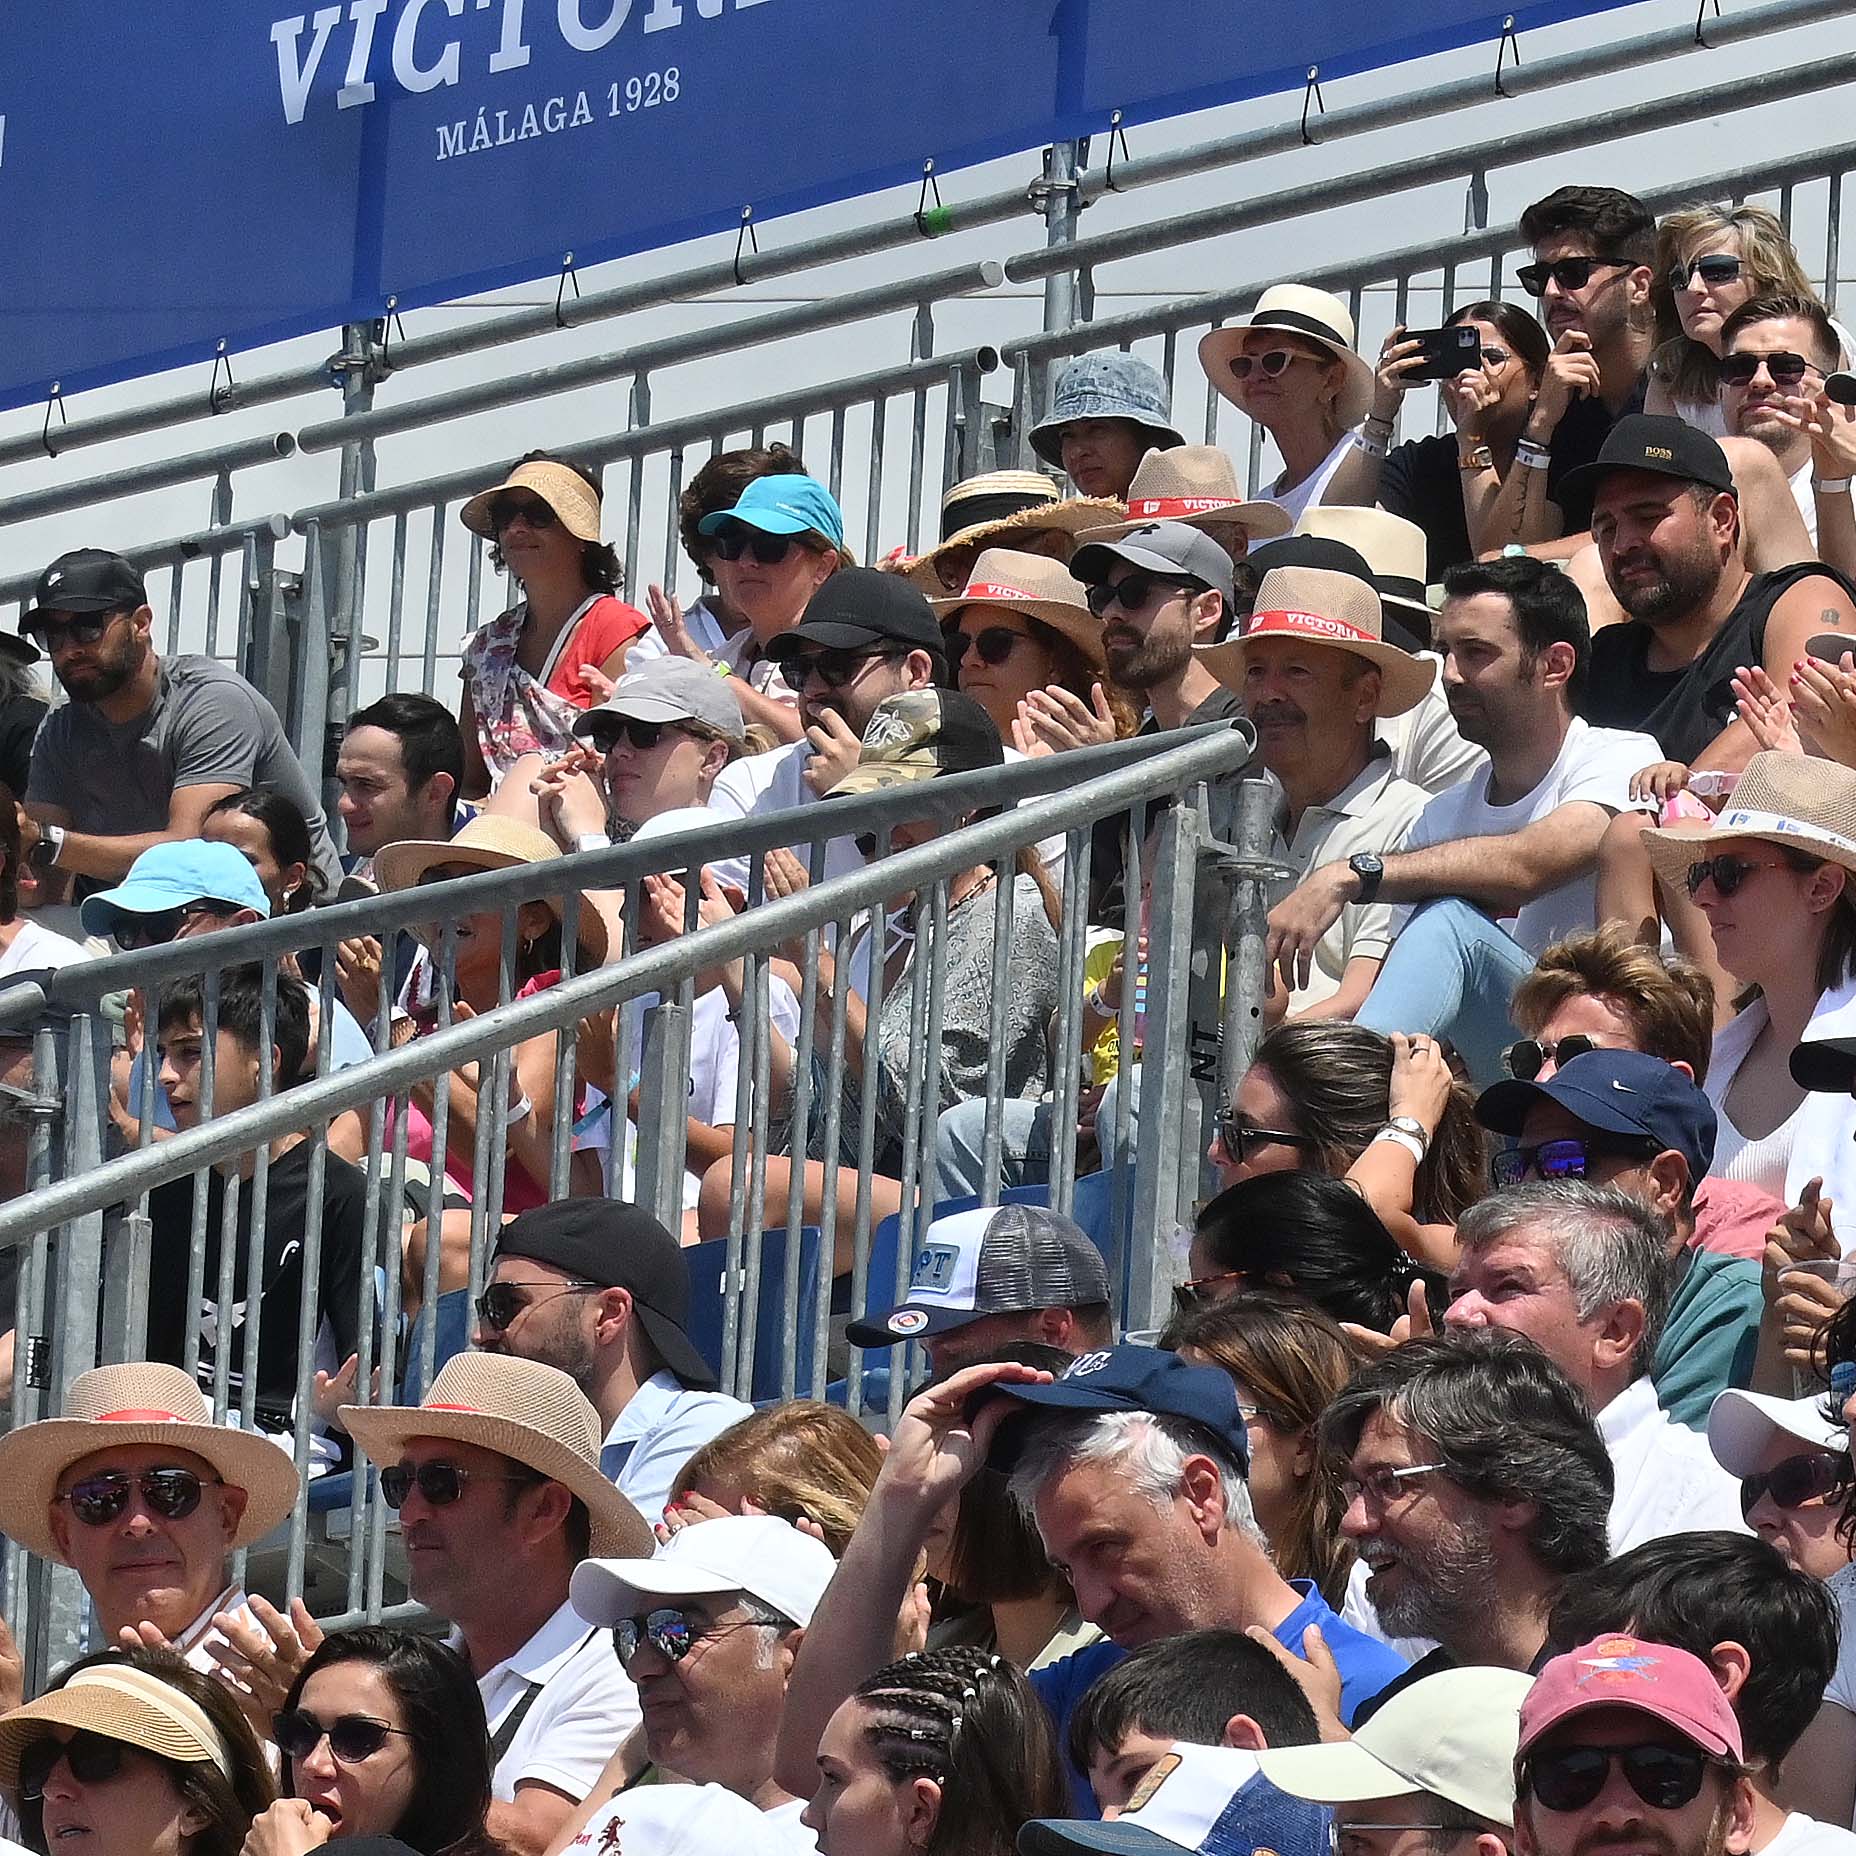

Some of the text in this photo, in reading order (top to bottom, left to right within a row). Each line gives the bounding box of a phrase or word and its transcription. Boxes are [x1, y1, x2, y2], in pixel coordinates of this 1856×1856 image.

[436, 67, 683, 161] MÁLAGA 1928
[1645, 446, 1672, 459] BOSS
[1286, 613, 1359, 640] VICTORIA
